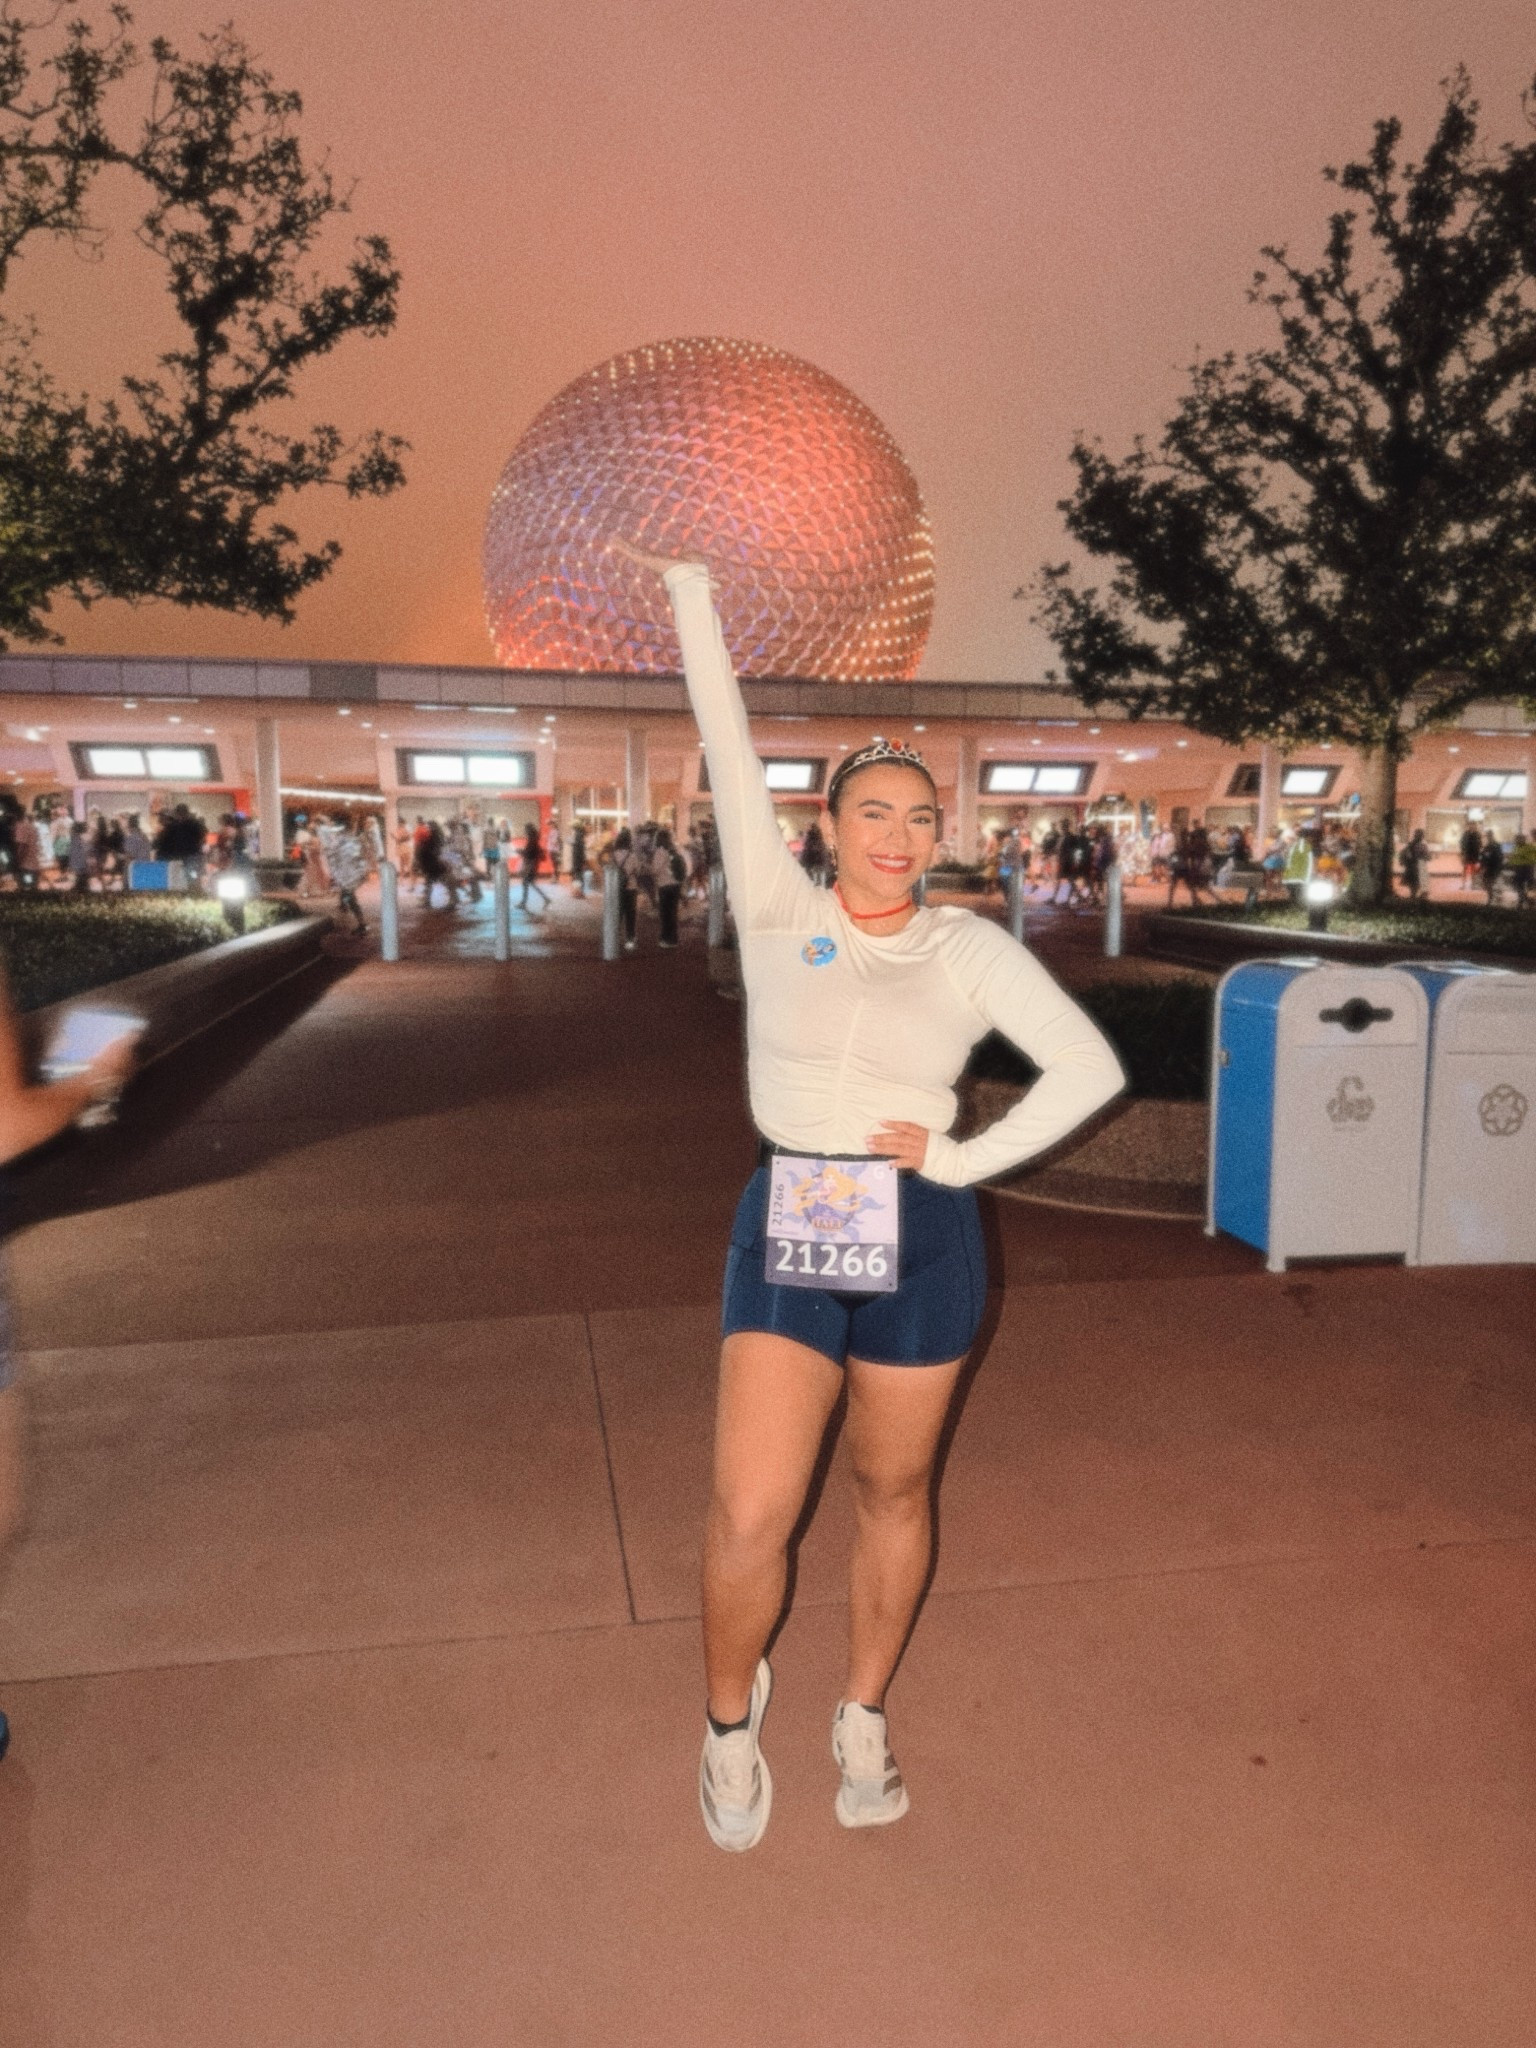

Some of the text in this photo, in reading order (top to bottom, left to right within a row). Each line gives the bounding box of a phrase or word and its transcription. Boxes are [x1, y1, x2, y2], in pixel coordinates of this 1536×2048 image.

[873, 1165, 885, 1180] G
[772, 1183, 785, 1227] 21266
[775, 1240, 888, 1278] 21266
